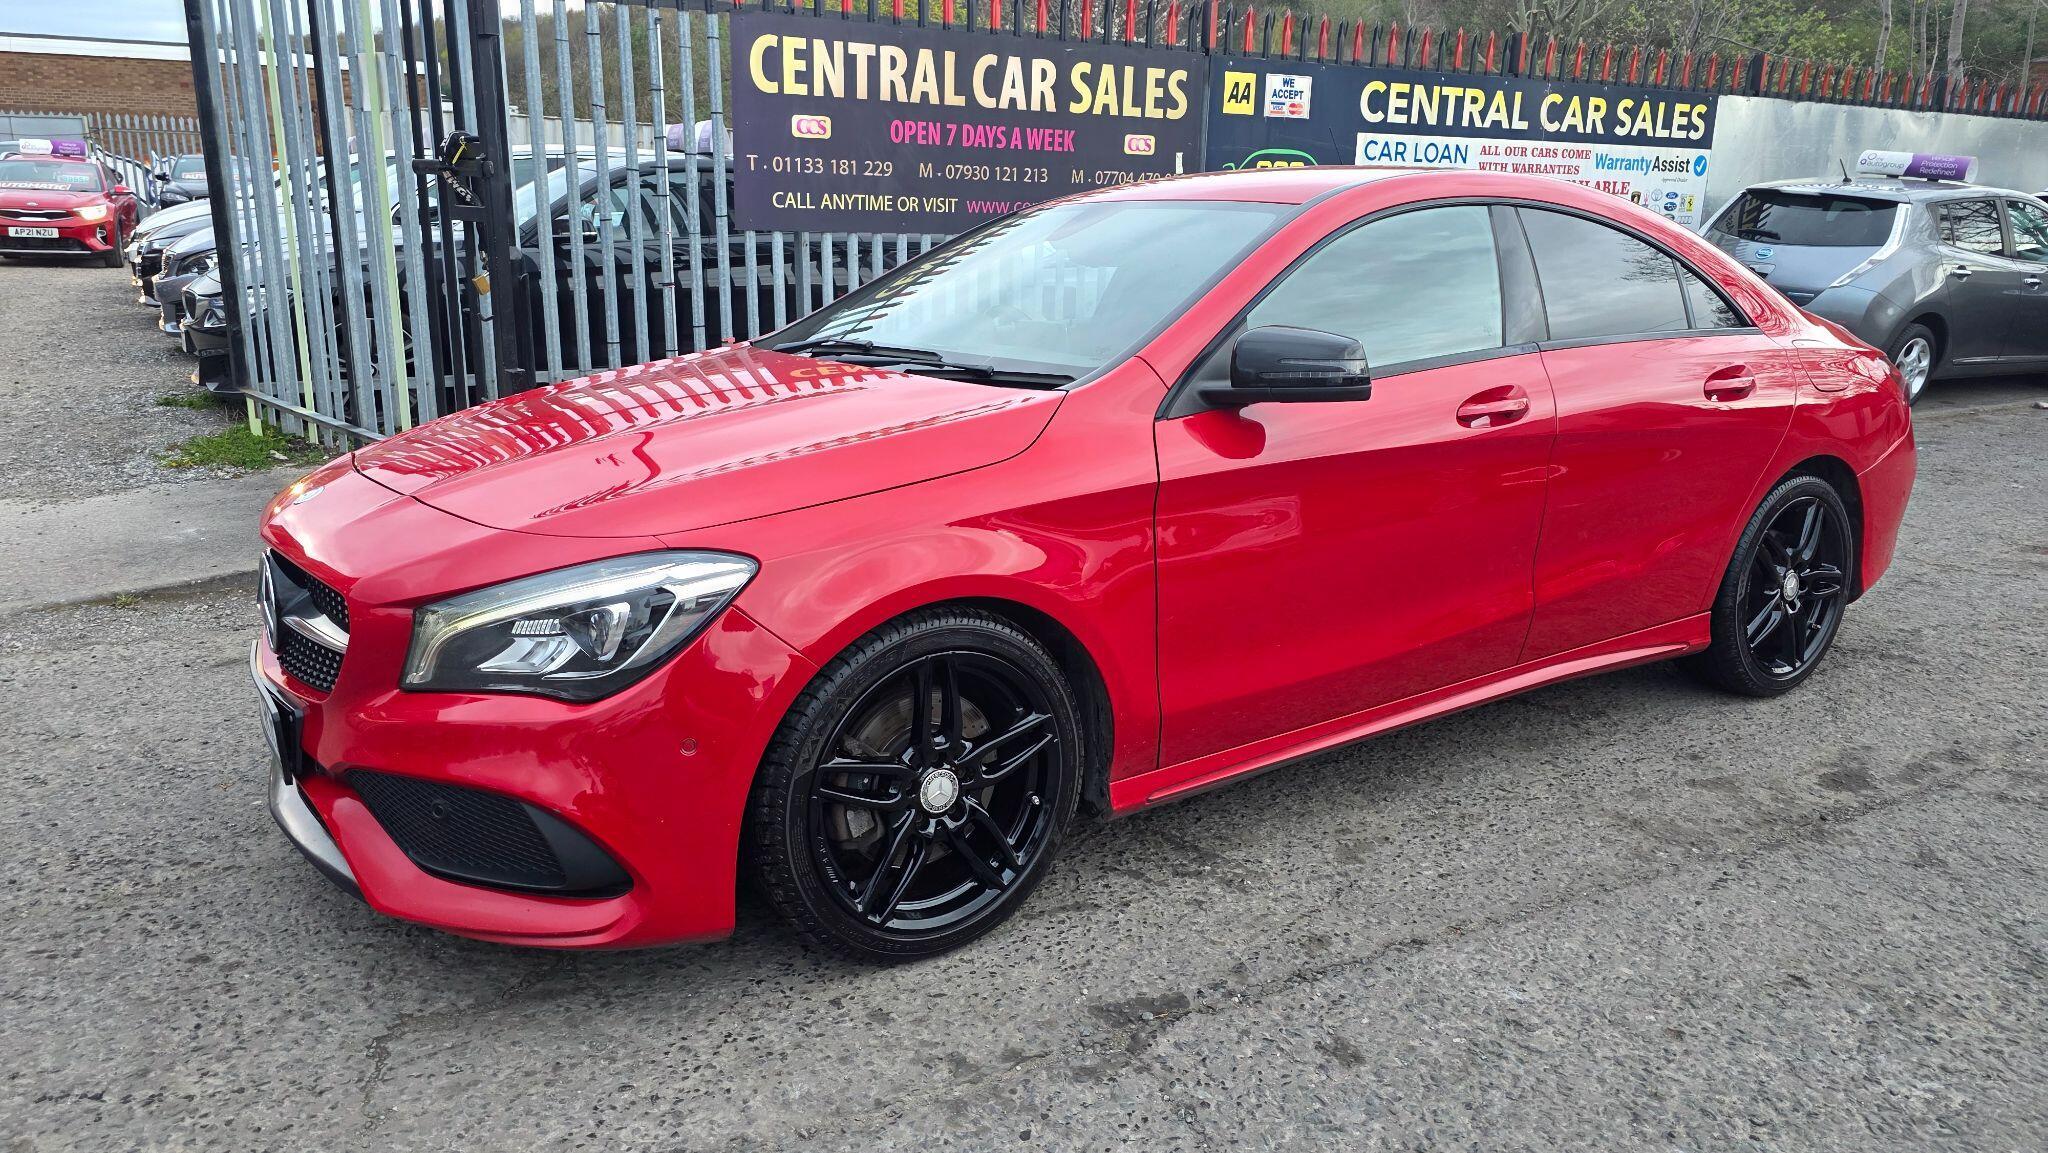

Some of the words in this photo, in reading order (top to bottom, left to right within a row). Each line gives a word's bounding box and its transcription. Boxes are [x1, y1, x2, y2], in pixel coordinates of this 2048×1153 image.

[749, 33, 966, 107] CENTRAL
[972, 53, 1057, 113] CAR
[1069, 61, 1188, 120] SALES
[1282, 77, 1296, 88] WE
[1227, 81, 1251, 104] AA
[1271, 88, 1304, 100] ACCEPT
[1359, 80, 1529, 130] CENTRAL
[1539, 93, 1607, 135] CAR
[1613, 98, 1708, 141] SALES
[890, 119, 941, 145] OPEN
[946, 123, 957, 146] 7
[962, 123, 1007, 148] DAYS
[1010, 127, 1023, 149] A
[1026, 127, 1076, 152] WEEK
[1364, 139, 1407, 161] CAR
[1413, 142, 1469, 164] LOAN
[1479, 145, 1501, 156] ALL
[1504, 146, 1528, 157] OUR
[1531, 147, 1559, 158] CARS
[1561, 148, 1592, 160] COME
[772, 156, 824, 174] 01133
[830, 159, 857, 176] 181
[863, 161, 893, 177] 229
[1478, 161, 1508, 173] WITH
[1512, 163, 1580, 175] WARRANTIES
[1919, 167, 1956, 176] Redefined
[1920, 160, 1959, 169] Protection
[945, 164, 990, 181] 07930
[994, 166, 1018, 182] 121
[1023, 167, 1048, 183] 213
[1095, 170, 1135, 185] 07704
[772, 192, 815, 209] CALL
[821, 193, 893, 211] ANYTIME
[897, 196, 919, 212] OR
[922, 197, 959, 213] VISIT
[14, 228, 34, 236] AP21
[36, 229, 54, 237] NZU
